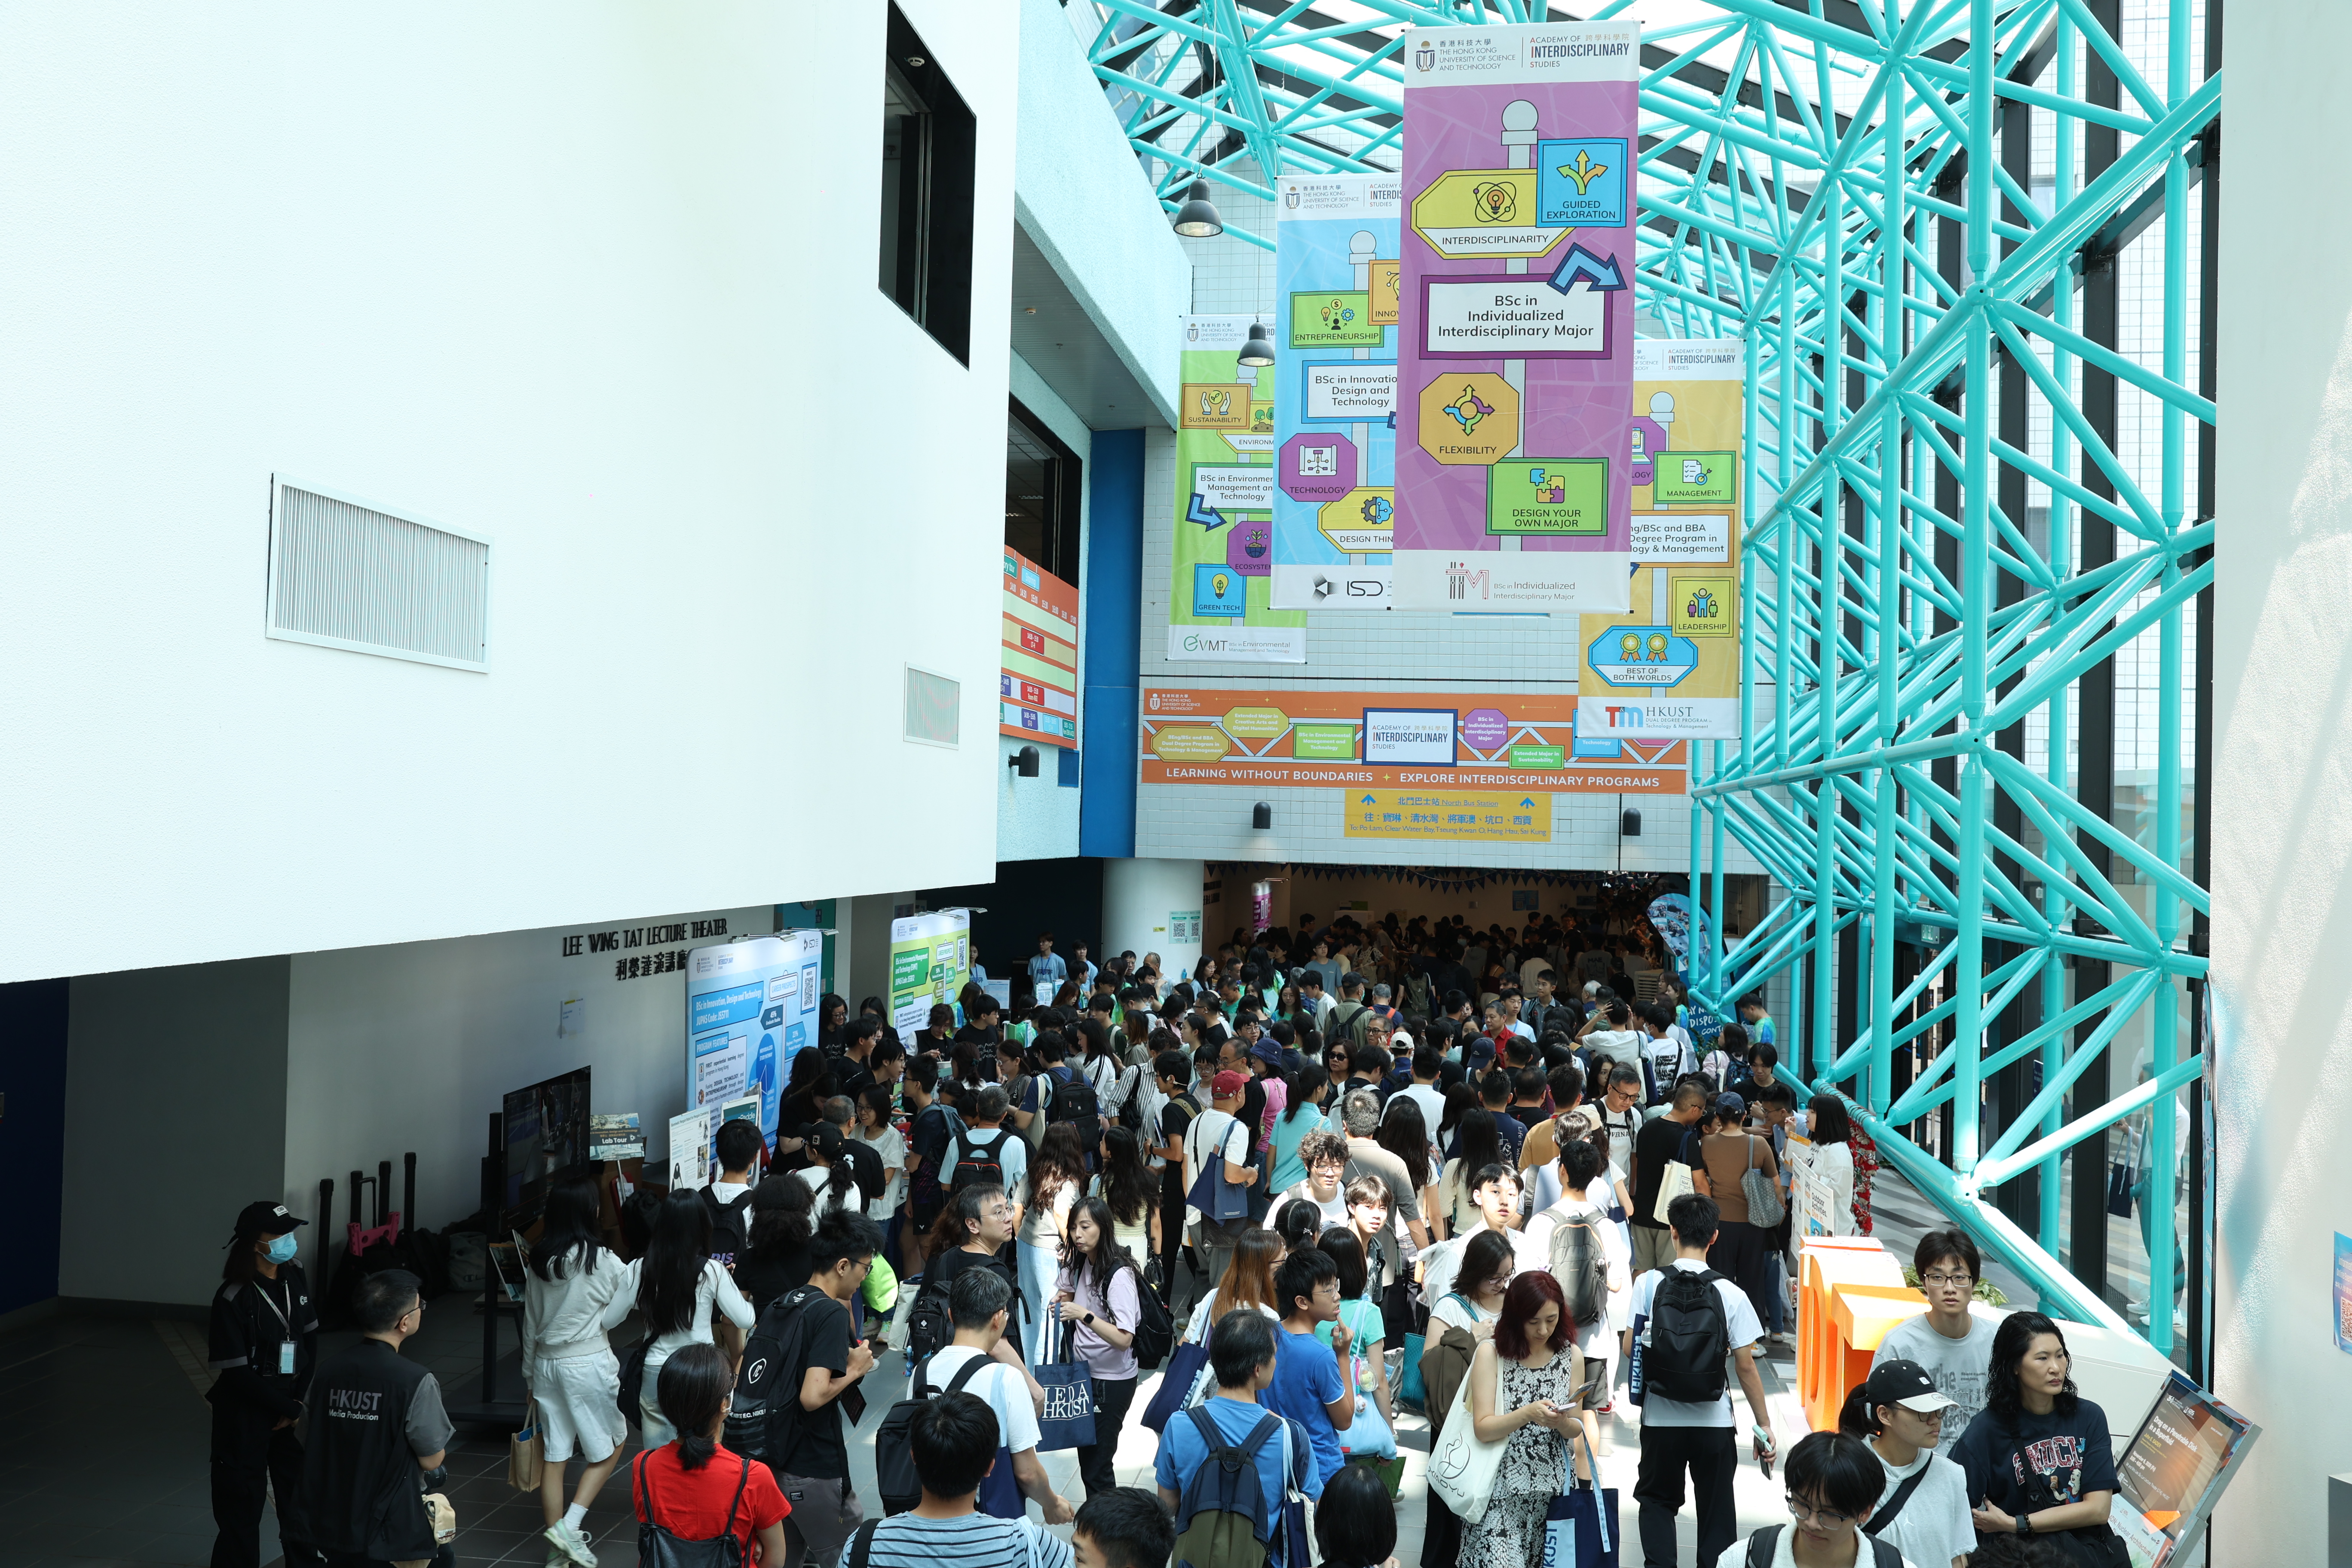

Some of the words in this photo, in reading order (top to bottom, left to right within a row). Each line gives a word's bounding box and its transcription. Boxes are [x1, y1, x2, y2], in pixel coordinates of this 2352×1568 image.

[1439, 38, 1491, 47] 香港科技大學
[1585, 33, 1629, 42] 跨學科學院
[1531, 43, 1629, 58] INTERDISCIPLINARY
[1442, 235, 1549, 245] INTERDISCIPLINARITY
[1495, 295, 1521, 306] BSc
[1526, 295, 1537, 306] in
[1468, 310, 1563, 321] Individualized
[1439, 326, 1550, 338] Interdisciplinary
[1554, 325, 1593, 338] Major
[1669, 355, 1735, 364] INTERDISCIPLINARY
[1350, 375, 1397, 383] Innovatio
[1332, 387, 1367, 396] Design
[1332, 398, 1390, 407] Technology
[1208, 484, 1261, 492] Management
[1220, 493, 1265, 501] Technology
[1544, 520, 1578, 528] MAJOR
[1630, 535, 1662, 544] Degree
[1665, 535, 1706, 544] Program
[1514, 581, 1575, 590] Individualized
[1646, 707, 1694, 717] HKUST
[1373, 732, 1448, 742] INTERDISCIPLINARY
[1167, 769, 1226, 778] LEARNING
[1231, 770, 1289, 779] WITHOUT
[1293, 772, 1373, 781] BOUNDARIES
[1400, 773, 1455, 783] EXPLORE
[1460, 775, 1583, 785] INTERDISCIPLINARY
[1588, 777, 1659, 787] PROGRAMS
[1398, 797, 1439, 805] 北門巴士站
[563, 936, 583, 957] LEE
[588, 931, 619, 953] WING
[624, 928, 643, 948] TAT
[647, 923, 687, 946] LECTURE
[691, 918, 727, 939] THEATER
[616, 949, 688, 981] 利榮達演講廳
[772, 984, 781, 993] CAREER
[782, 980, 796, 990] PROSPECTS
[707, 997, 726, 1009] Innovation,
[726, 994, 738, 1005] Design
[744, 989, 762, 1000] Technology
[696, 1015, 708, 1026] JUPAS
[708, 1013, 717, 1023] Code:
[718, 1010, 729, 1021] JS5711
[697, 1041, 712, 1053] PROGRAM
[713, 1036, 728, 1048] FEATURES
[1812, 1192, 1825, 1207] Outdoor
[1632, 1336, 1642, 1392] HKUST
[329, 1389, 382, 1410] HKUST
[1042, 1397, 1089, 1418] HKUST
[328, 1409, 346, 1418] Media
[347, 1411, 379, 1420] Production
[2153, 1416, 2163, 1427] Drag
[2171, 1428, 2189, 1446] Penetrable
[2188, 1440, 2198, 1452] Disk
[2156, 1428, 2174, 1446] Superfluid
[2109, 1515, 2117, 1526] 4DN:
[2116, 1522, 2130, 1540] Nuclear
[2129, 1533, 2152, 1557] Architecture
[1544, 1528, 1557, 1568] KUST
